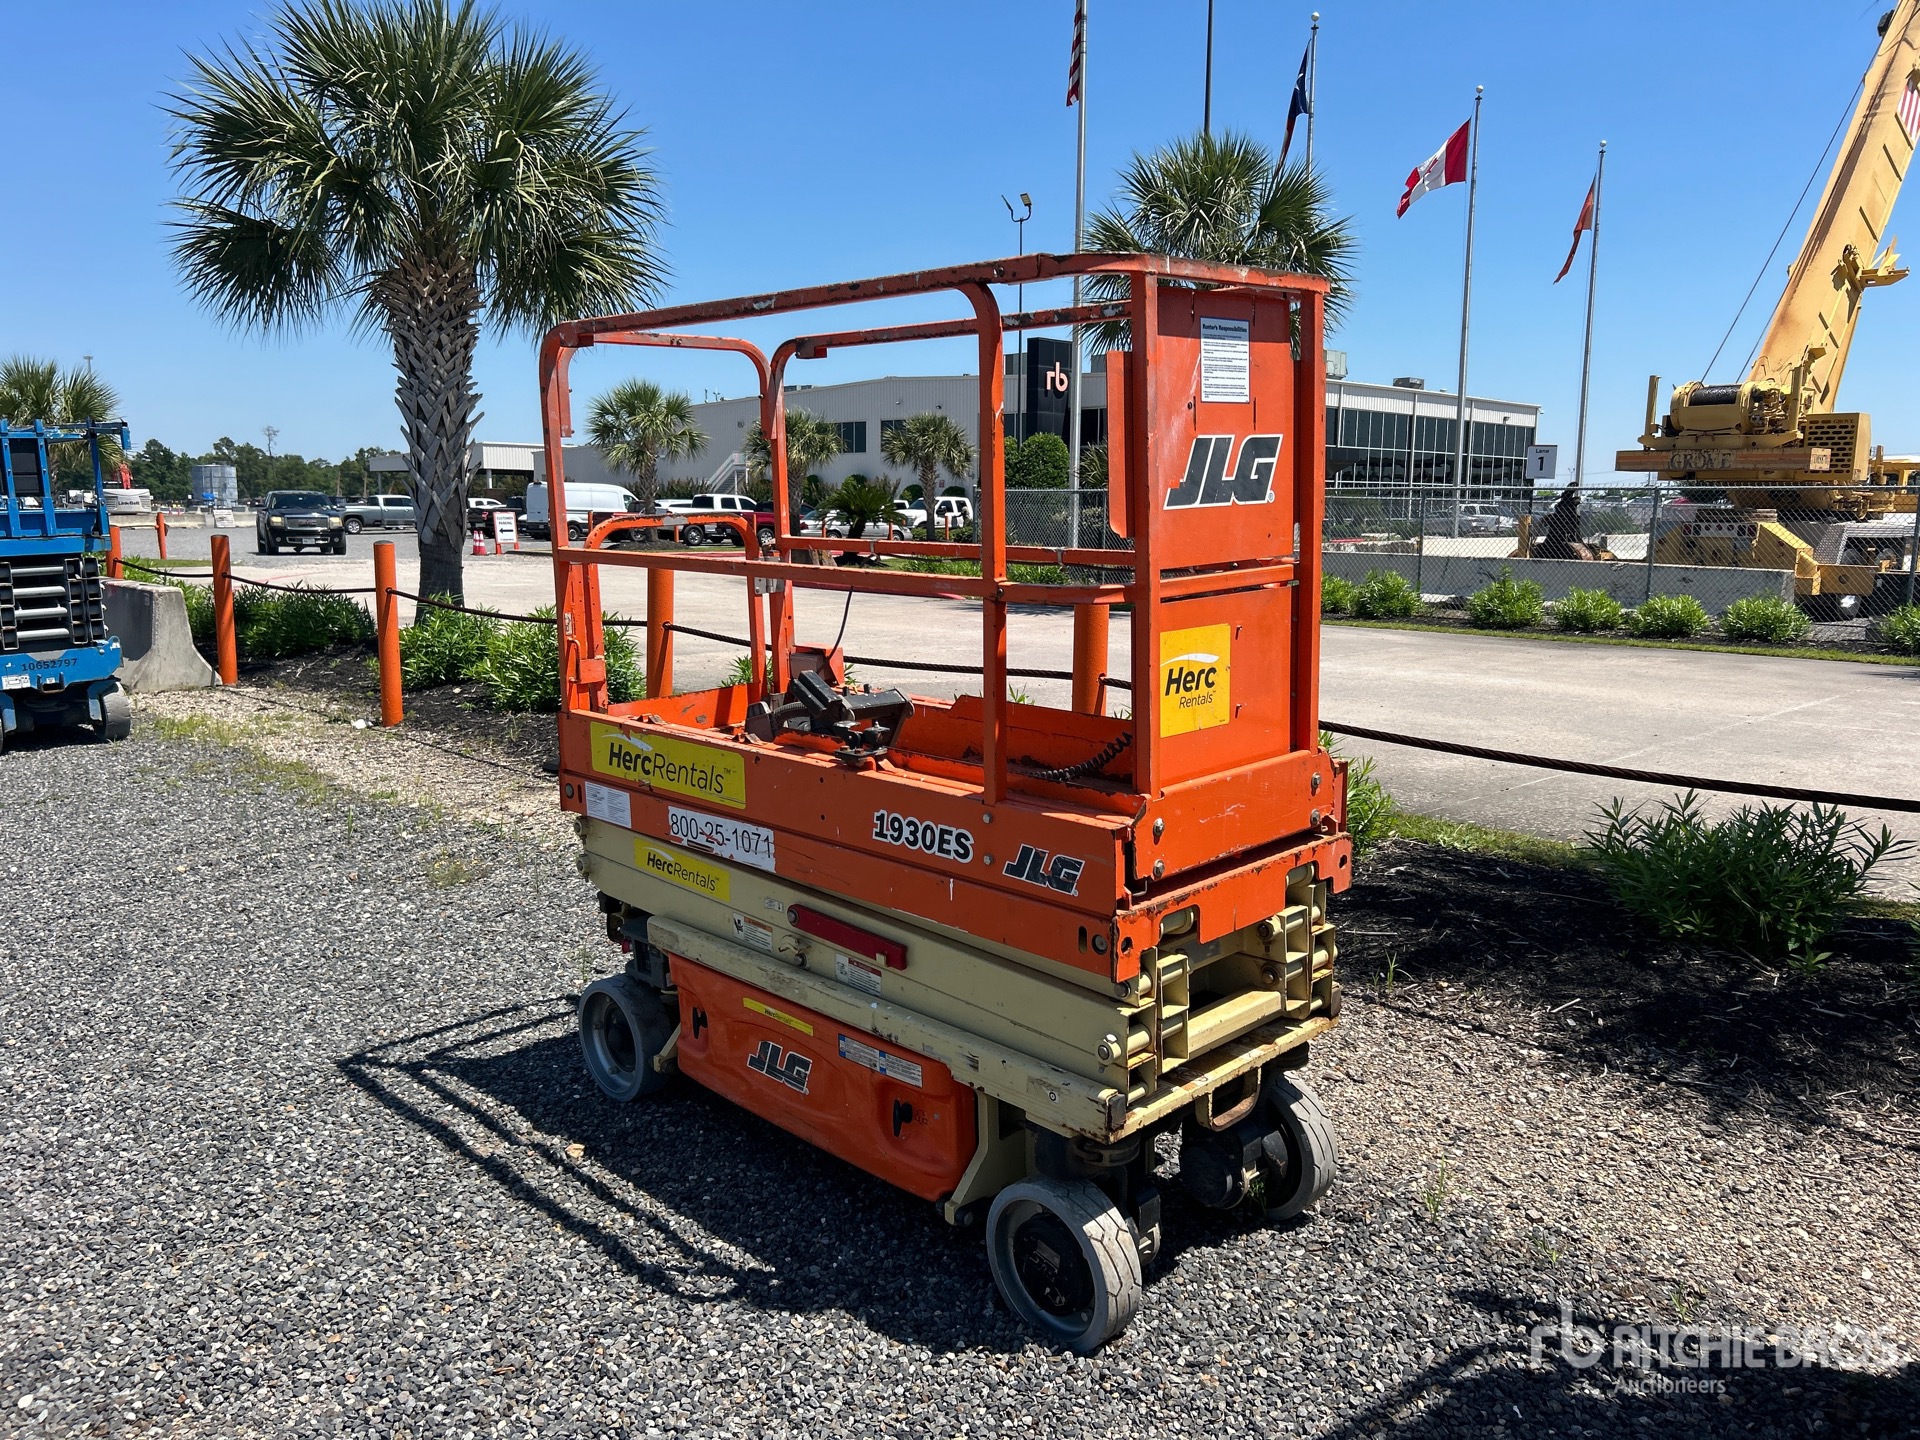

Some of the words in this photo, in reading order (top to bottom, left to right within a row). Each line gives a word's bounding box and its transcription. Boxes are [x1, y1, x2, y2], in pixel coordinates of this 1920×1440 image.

[1218, 325, 1248, 333] Responsibilities
[1046, 361, 1069, 392] rb
[1163, 434, 1283, 510] JLG
[1537, 456, 1545, 472] 1
[21, 657, 78, 672] 10652797
[1164, 666, 1218, 697] Herc
[1178, 691, 1214, 710] Rentals
[670, 813, 772, 859] 800-25-1071
[872, 809, 975, 864] 1930ES
[1002, 843, 1086, 896] JLG
[747, 1040, 813, 1094] JLG
